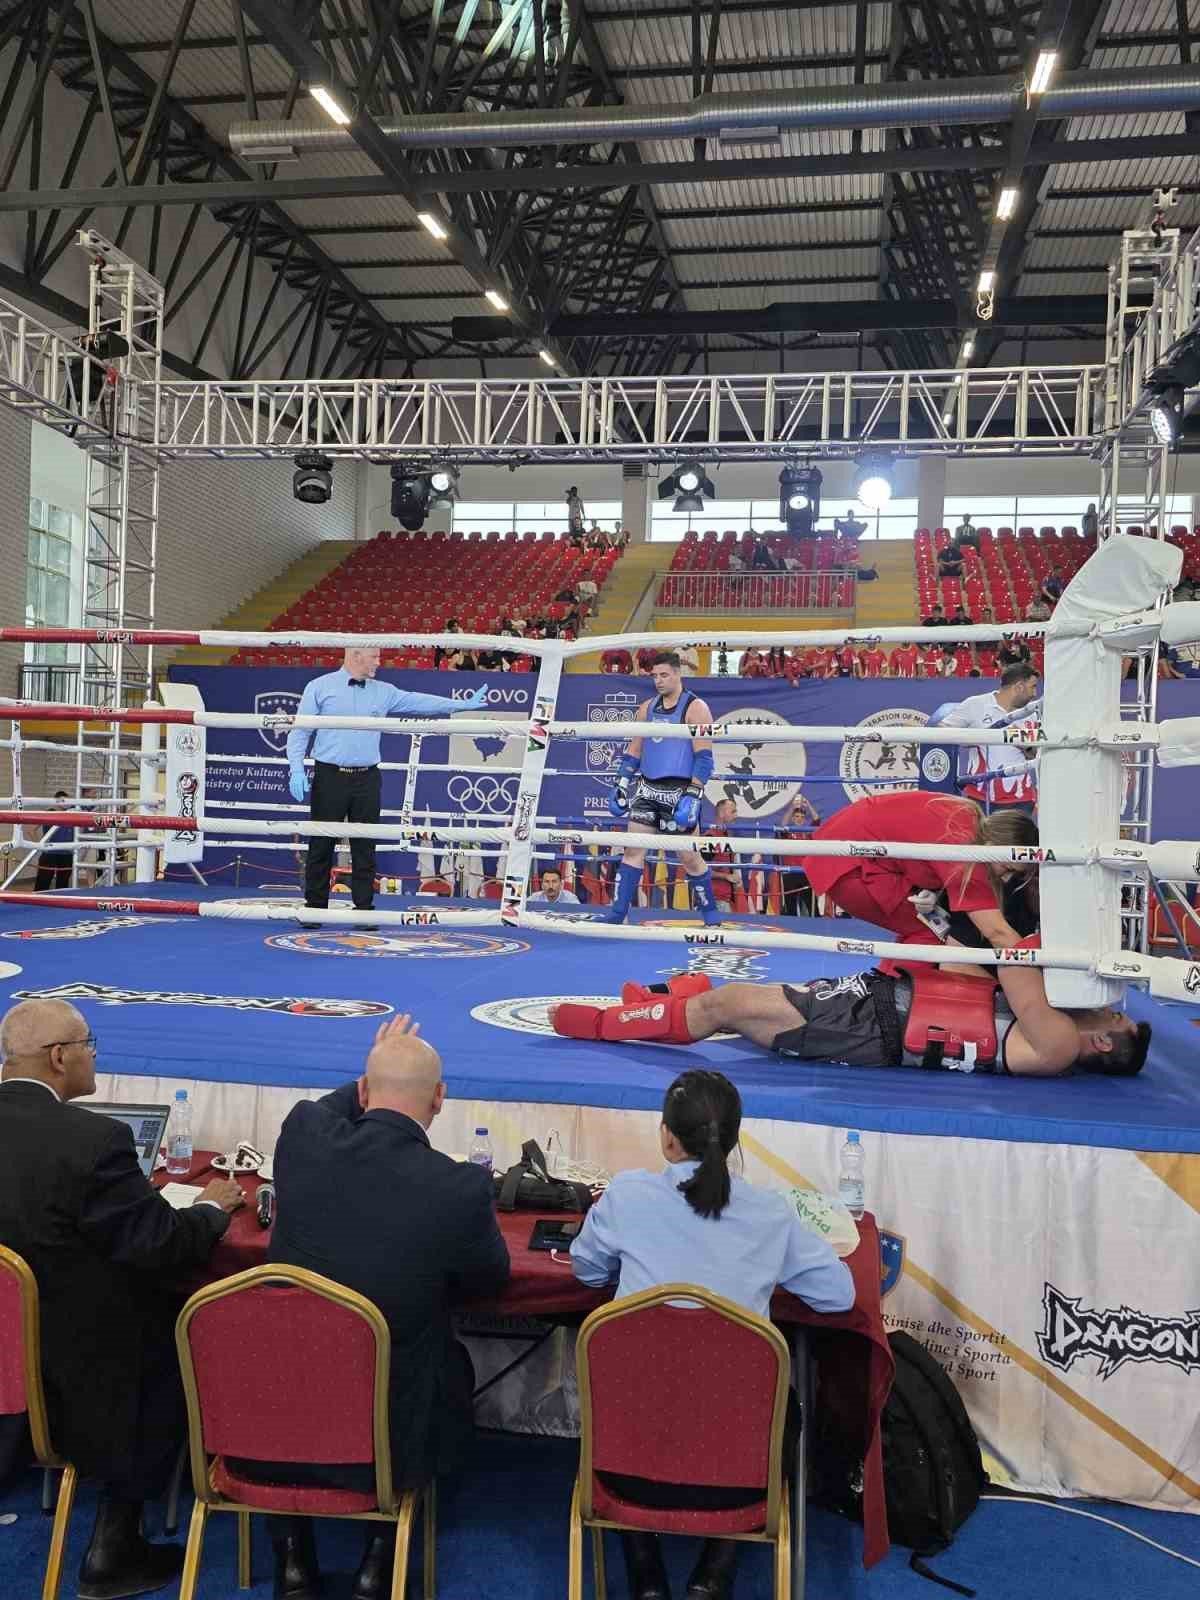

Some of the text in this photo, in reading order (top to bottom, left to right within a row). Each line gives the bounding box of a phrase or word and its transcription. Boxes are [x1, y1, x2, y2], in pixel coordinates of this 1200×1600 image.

[1003, 729, 1048, 744] IFMA
[246, 767, 285, 779] Kulture,
[234, 780, 243, 791] of
[246, 780, 286, 792] Culture,
[584, 796, 609, 808] PRIS
[692, 842, 733, 854] IFMA
[1011, 847, 1057, 861] IFMA
[400, 913, 440, 926] IFMA
[927, 1321, 952, 1336] dhe
[955, 1326, 1007, 1345] Sportit
[1042, 1293, 1200, 1367] DRAGON
[962, 1346, 1012, 1365] Sporta
[957, 1363, 998, 1381] Sport
